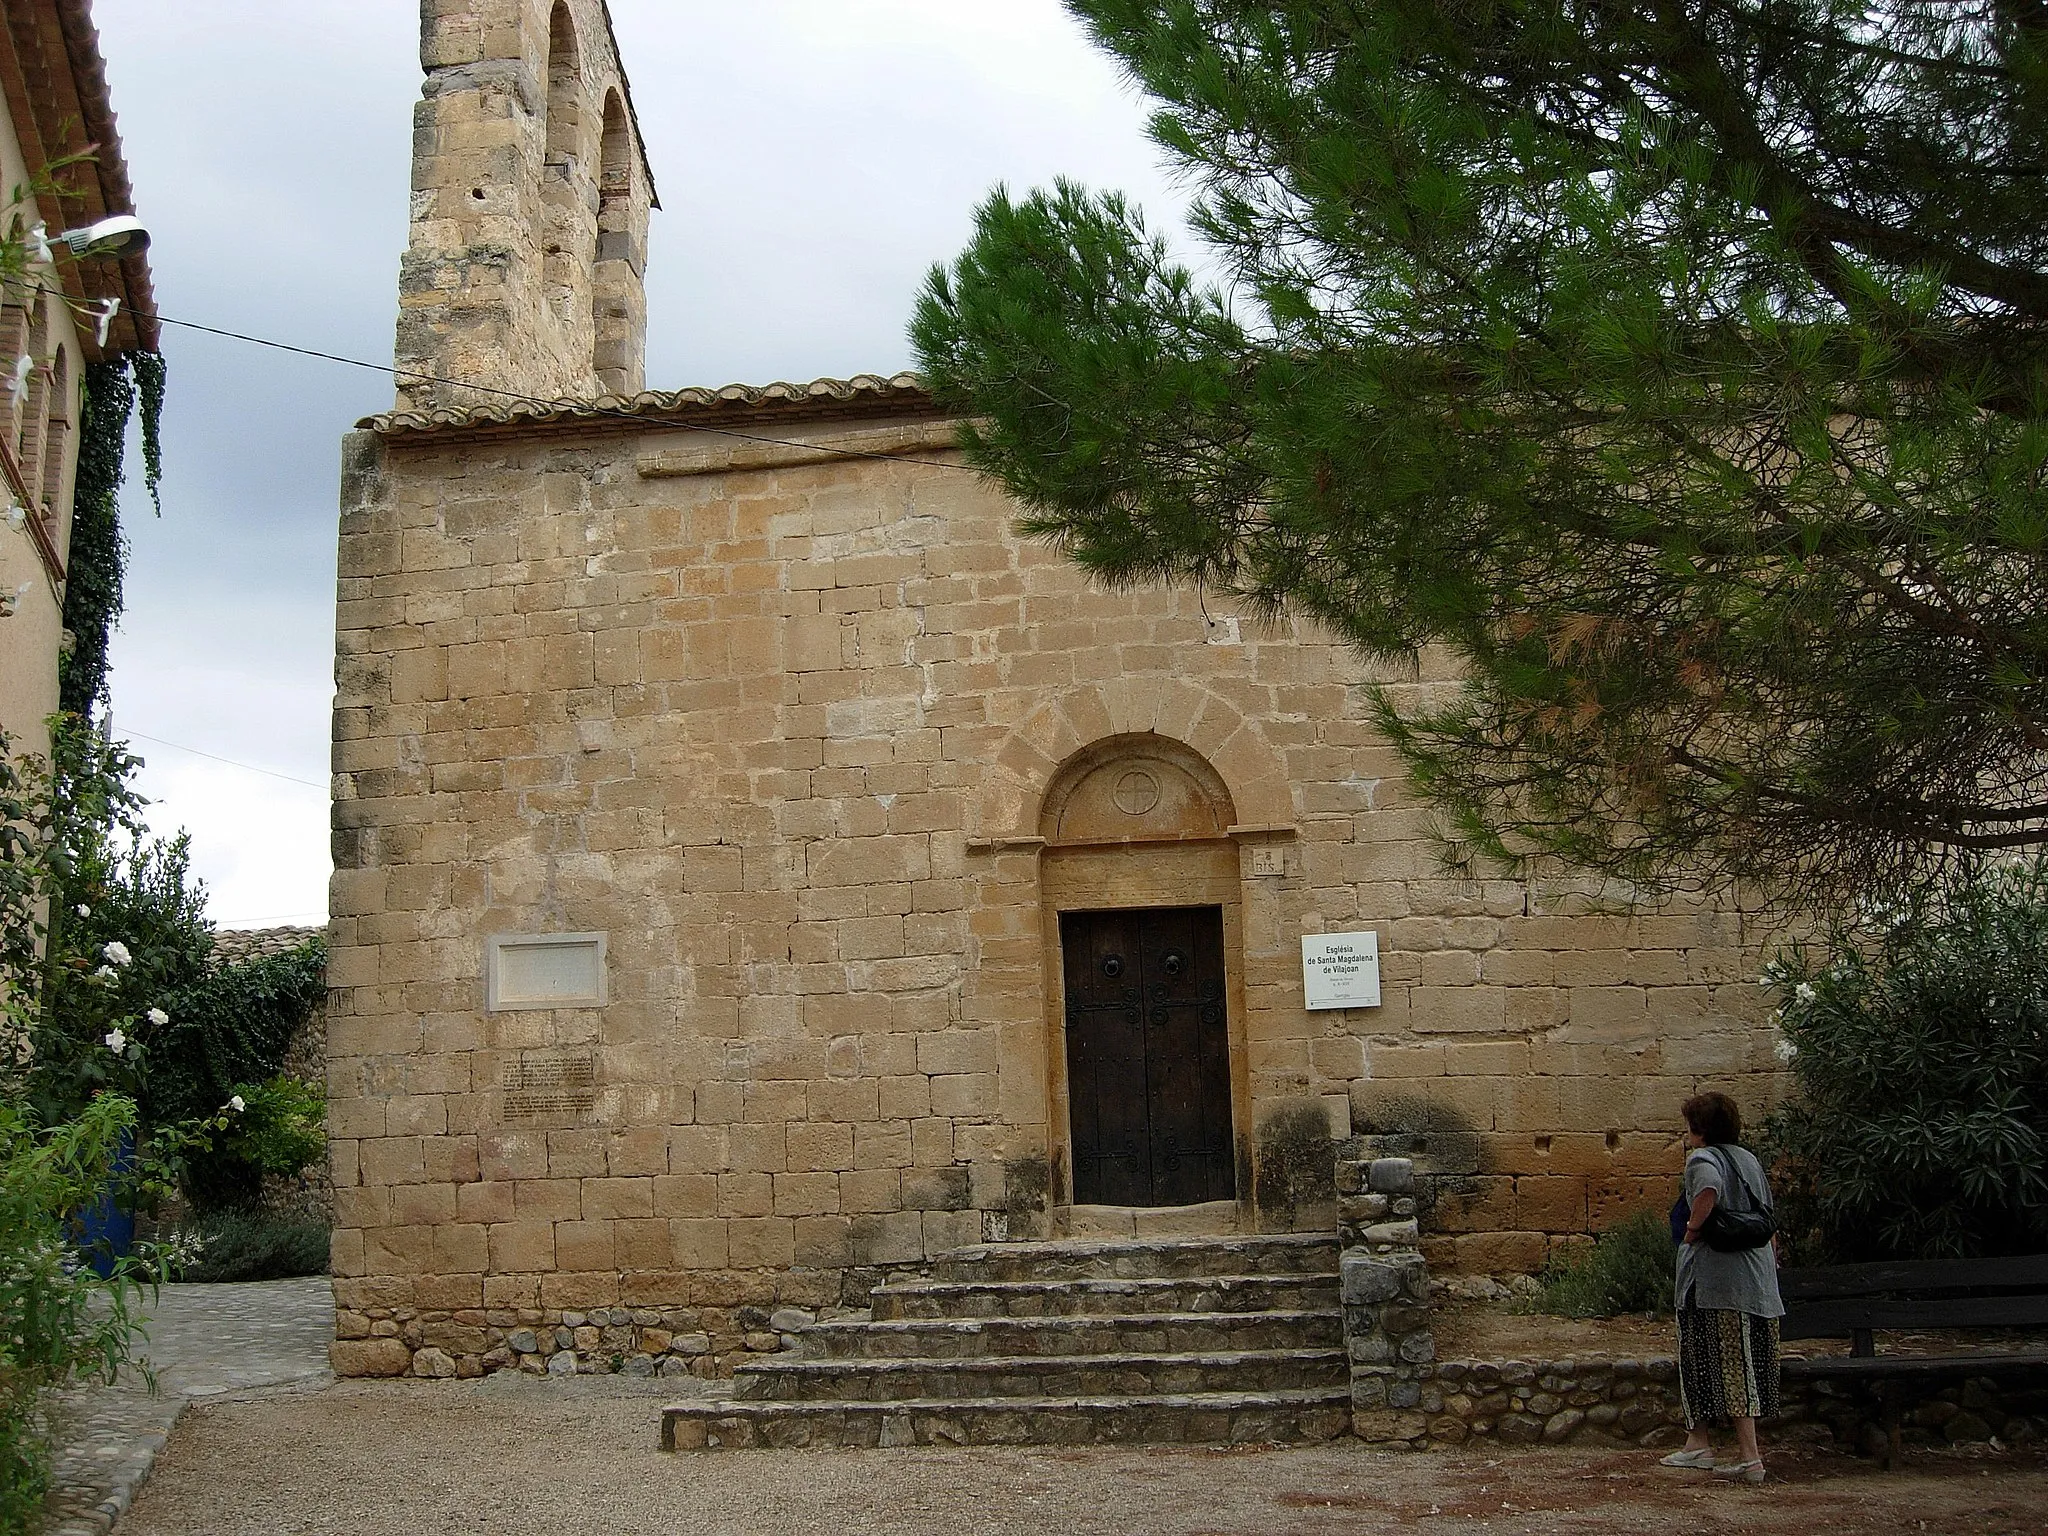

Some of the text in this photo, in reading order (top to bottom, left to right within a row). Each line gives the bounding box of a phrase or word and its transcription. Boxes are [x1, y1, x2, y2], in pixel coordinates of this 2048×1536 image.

[1326, 945, 1353, 955] Església
[1307, 954, 1373, 965] de Santa Magdalena
[1332, 965, 1359, 975] Vilajoan
